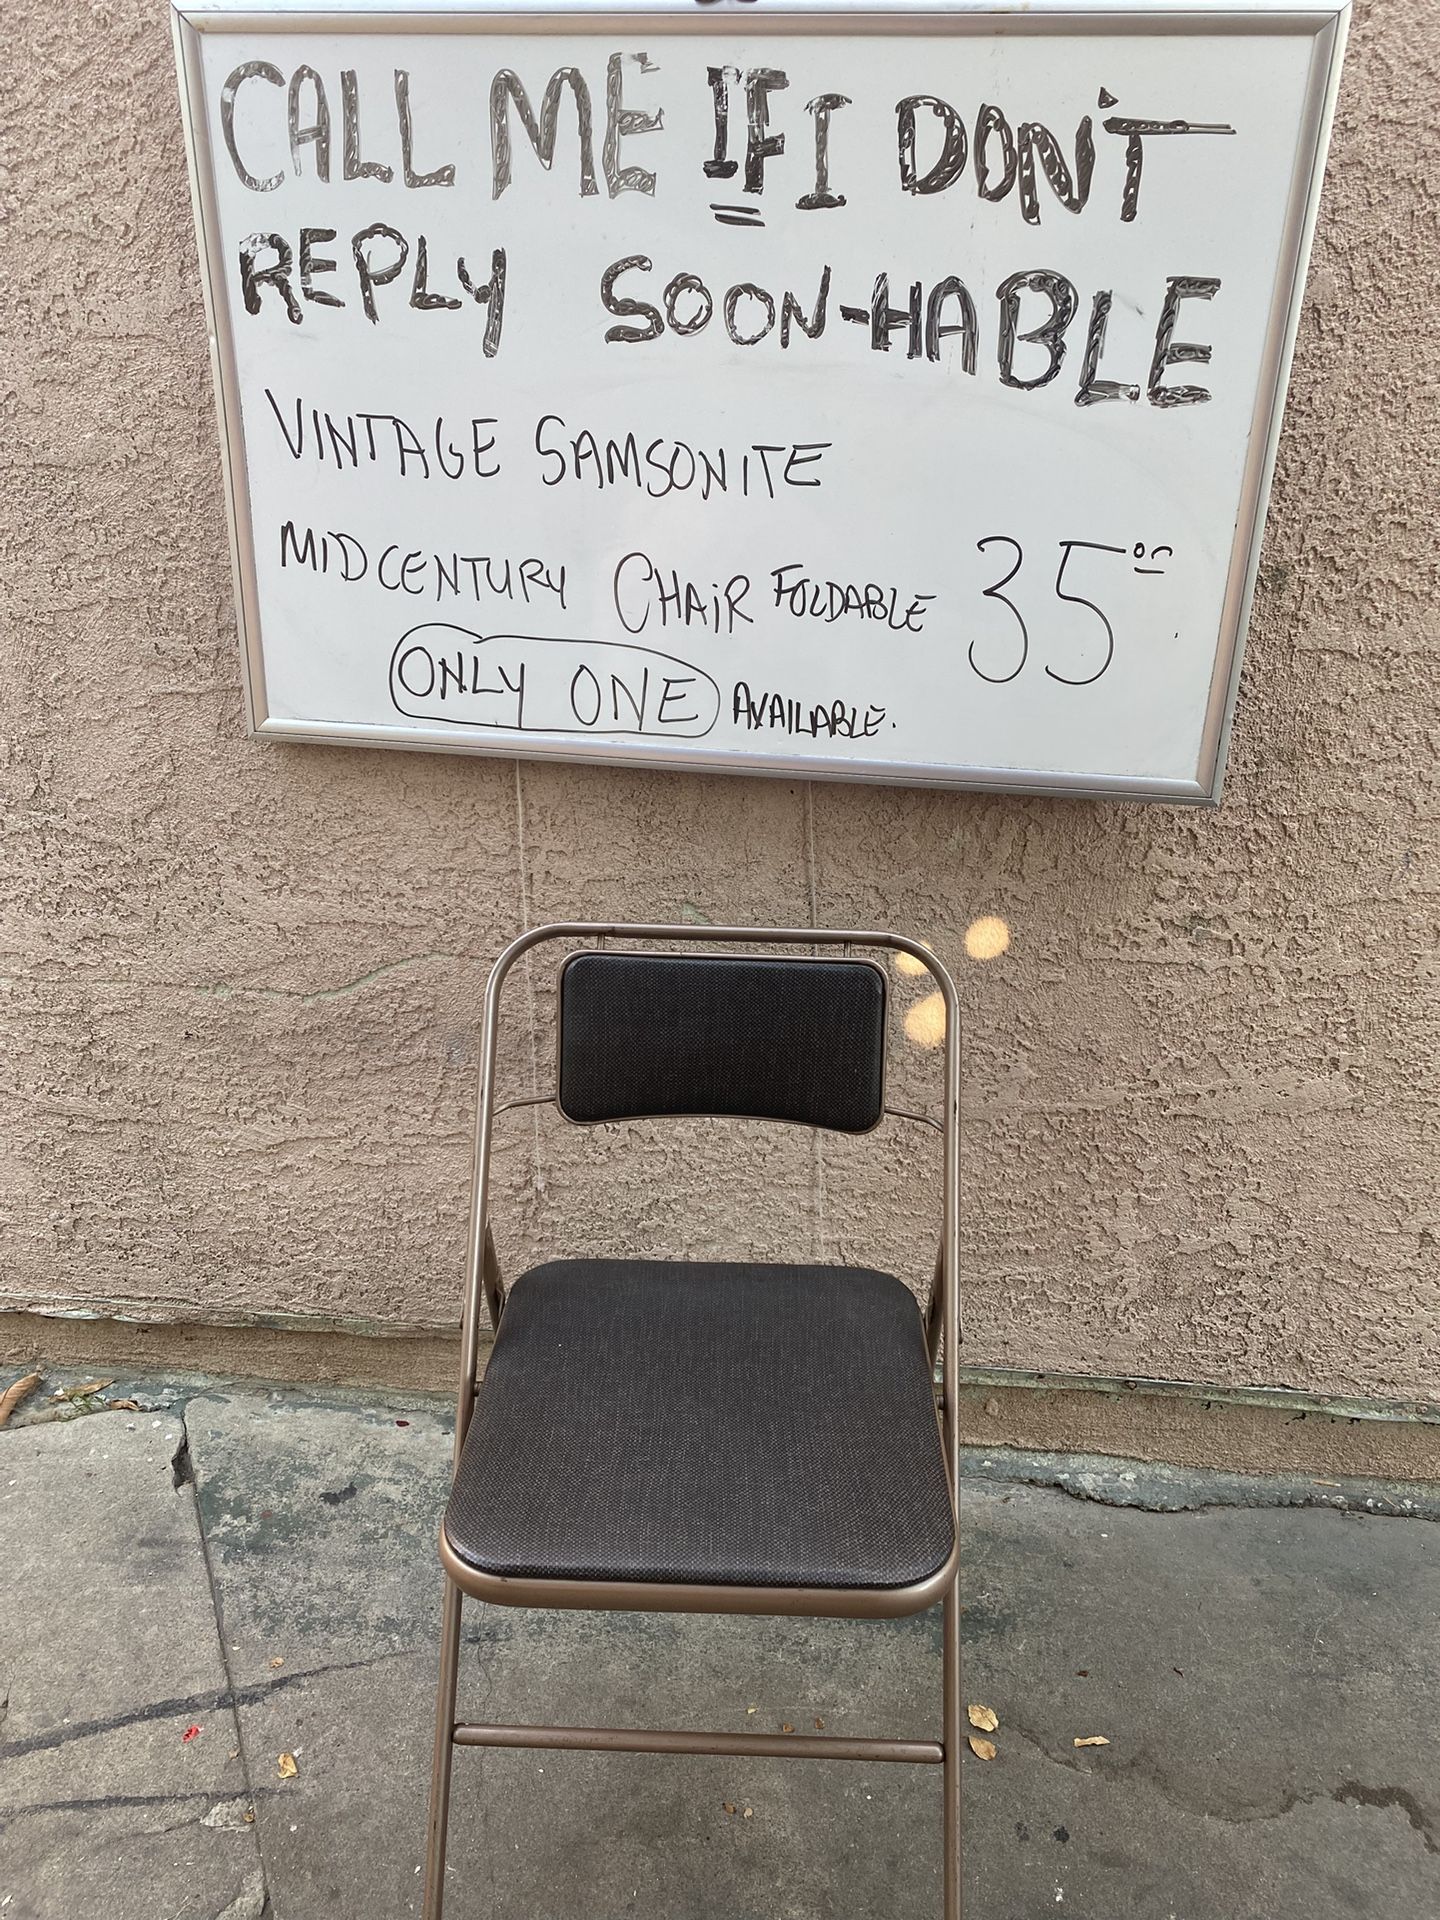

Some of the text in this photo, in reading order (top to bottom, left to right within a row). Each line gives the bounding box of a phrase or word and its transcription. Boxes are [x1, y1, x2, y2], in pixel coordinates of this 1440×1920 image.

[220, 60, 456, 193] CALL
[488, 51, 665, 201] ME
[702, 65, 790, 195] IF
[795, 93, 852, 210] I
[238, 222, 507, 359] REPLY
[264, 387, 833, 500] VINTAGE SAMSONITE
[770, 564, 937, 633] FOLDABLE
[397, 645, 526, 729] ONLY
[570, 663, 698, 731] ONE
